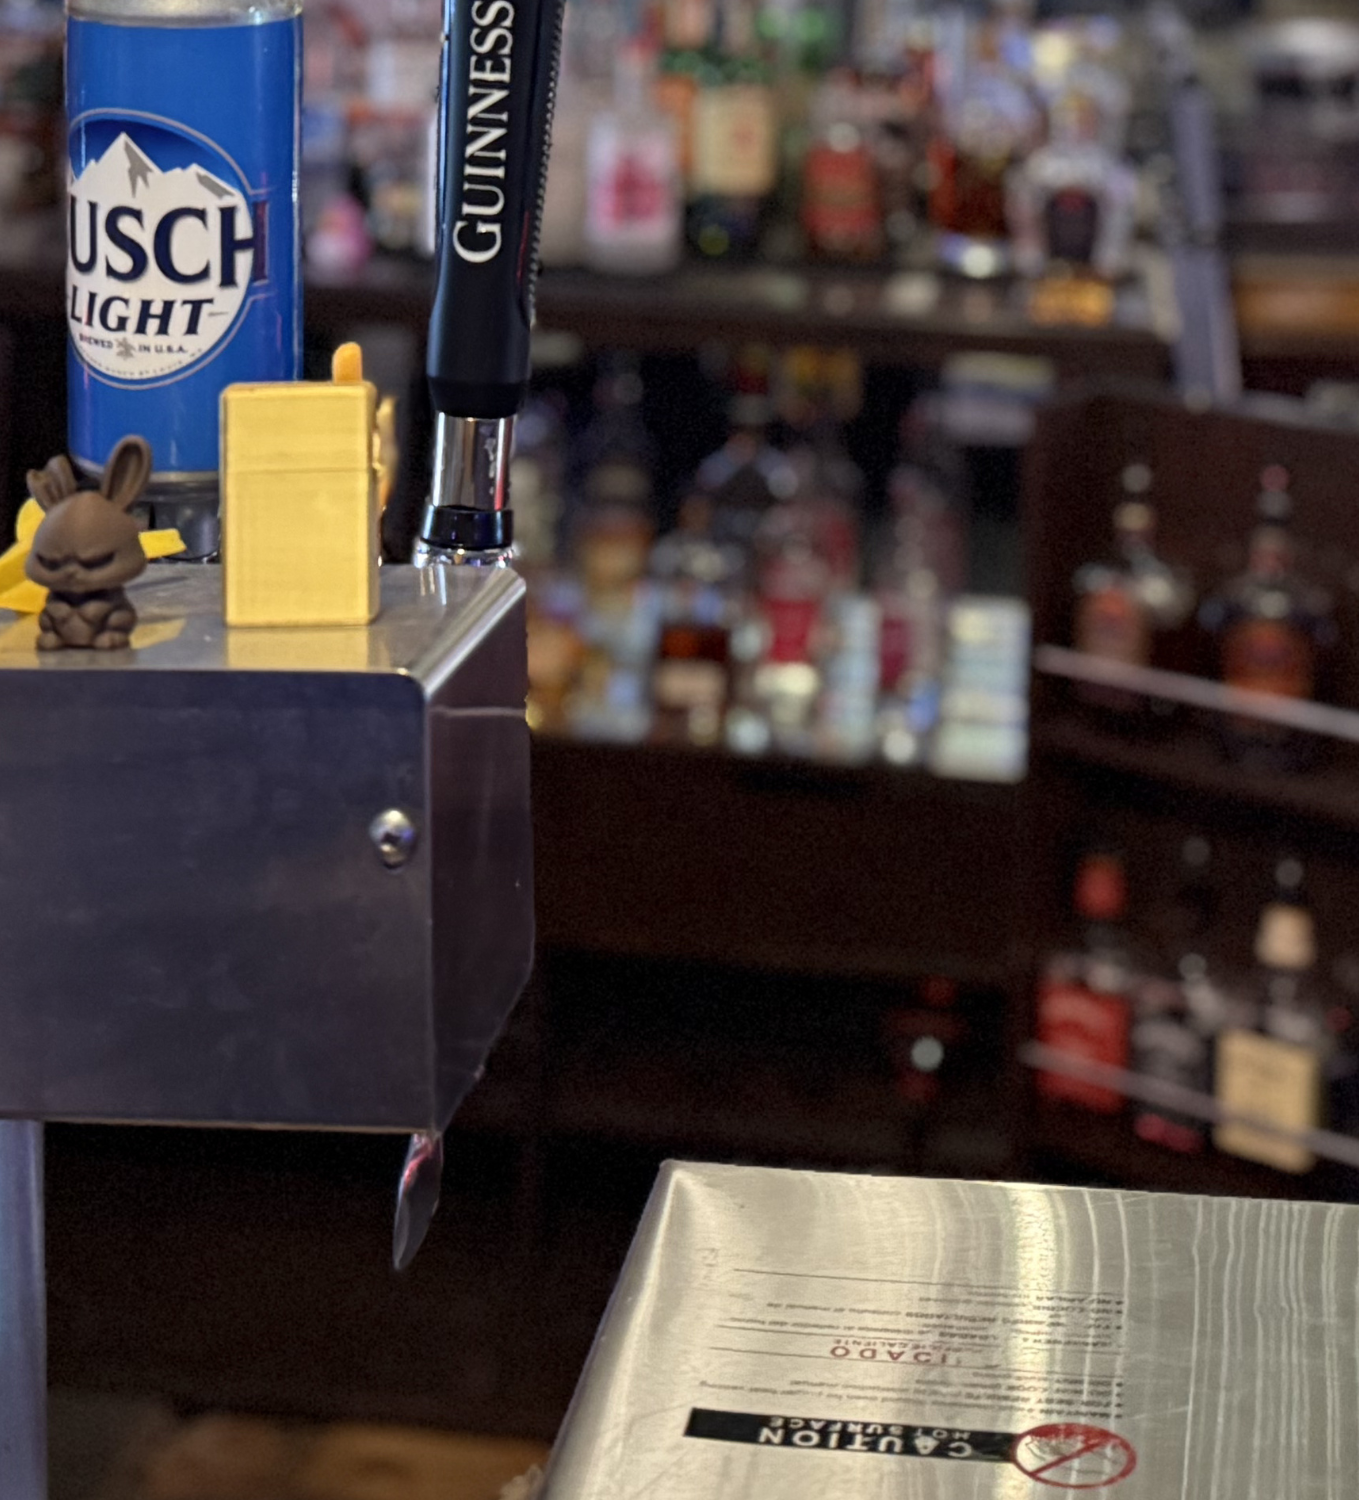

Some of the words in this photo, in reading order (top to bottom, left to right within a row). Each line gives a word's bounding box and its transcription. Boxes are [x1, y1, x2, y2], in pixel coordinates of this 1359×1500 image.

[70, 194, 270, 289] USCH
[70, 284, 214, 336] LIGHT
[138, 343, 151, 354] IN
[768, 1416, 903, 1435] SURFACE
[912, 1427, 970, 1440] HOT
[757, 1425, 972, 1458] CAUTION
